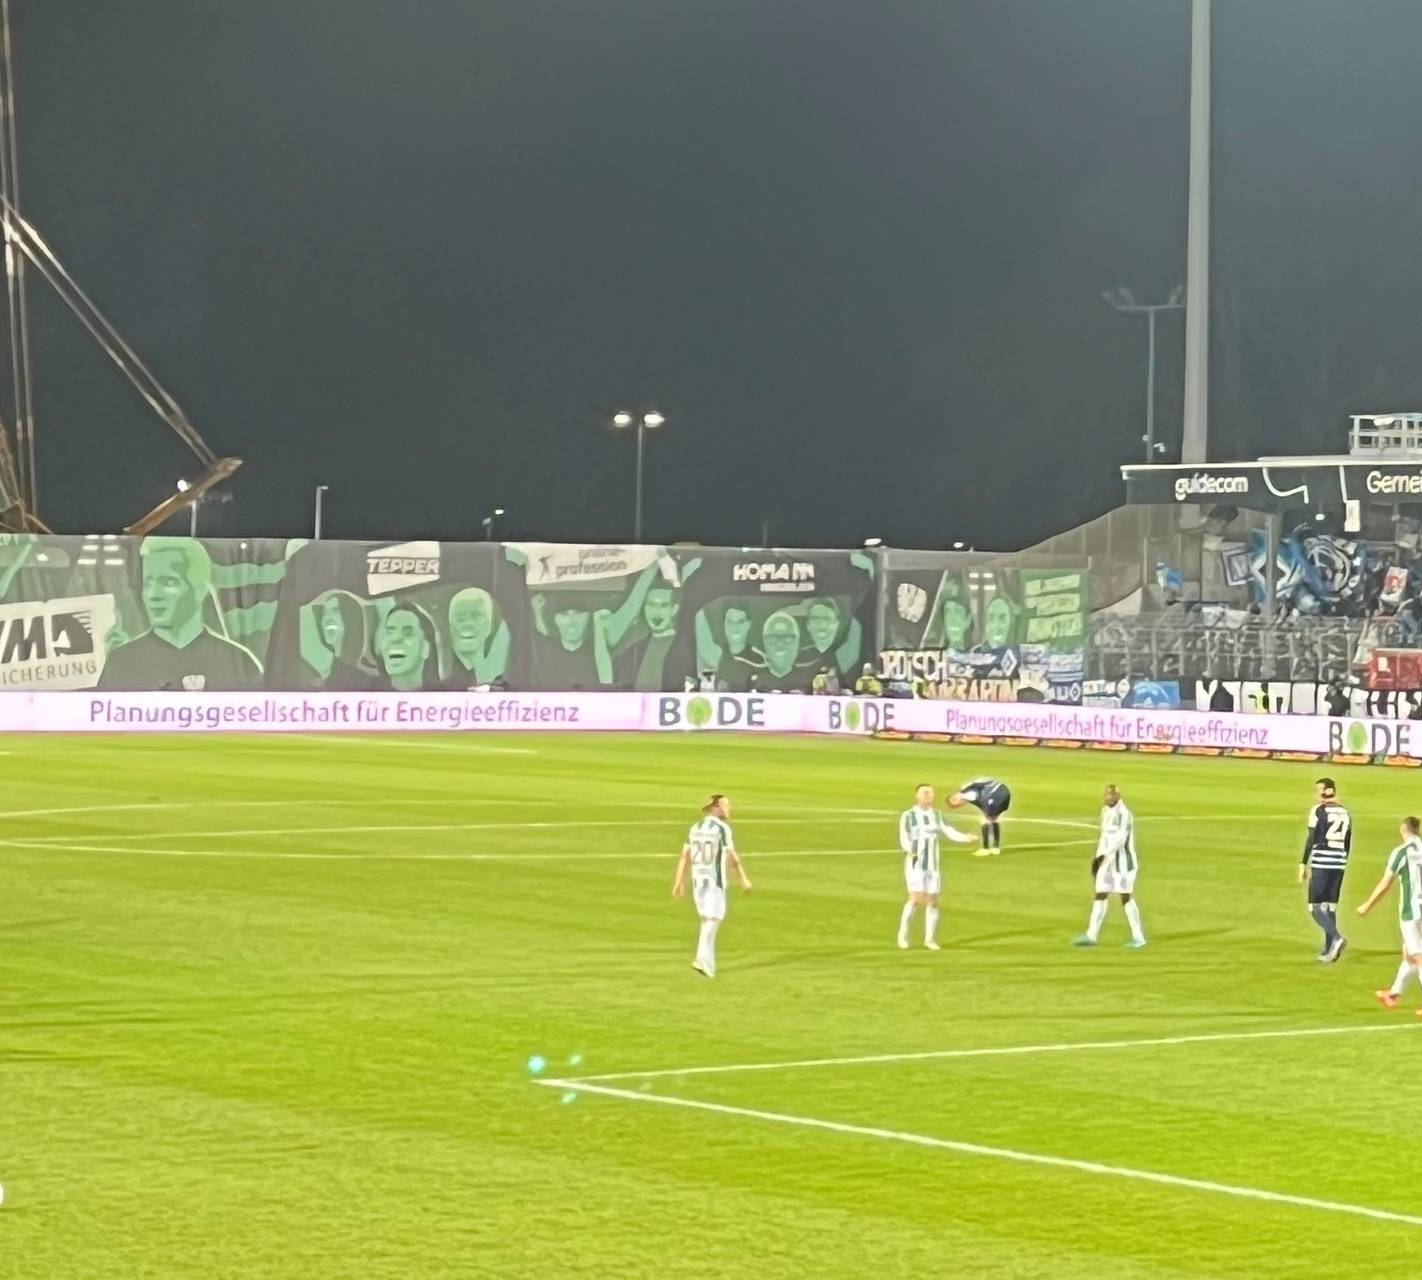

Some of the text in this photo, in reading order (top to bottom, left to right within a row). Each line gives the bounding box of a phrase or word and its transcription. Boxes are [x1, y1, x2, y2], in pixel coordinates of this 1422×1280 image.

[1175, 472, 1249, 501] guidecom
[367, 558, 439, 574] TEPPER
[90, 699, 580, 729] Planungsgesellschaft für Energieeffizienz
[658, 695, 766, 727] BODE
[828, 699, 895, 732] BODE
[946, 708, 1270, 746] Planungsgesellschaft für Energieeffizienz
